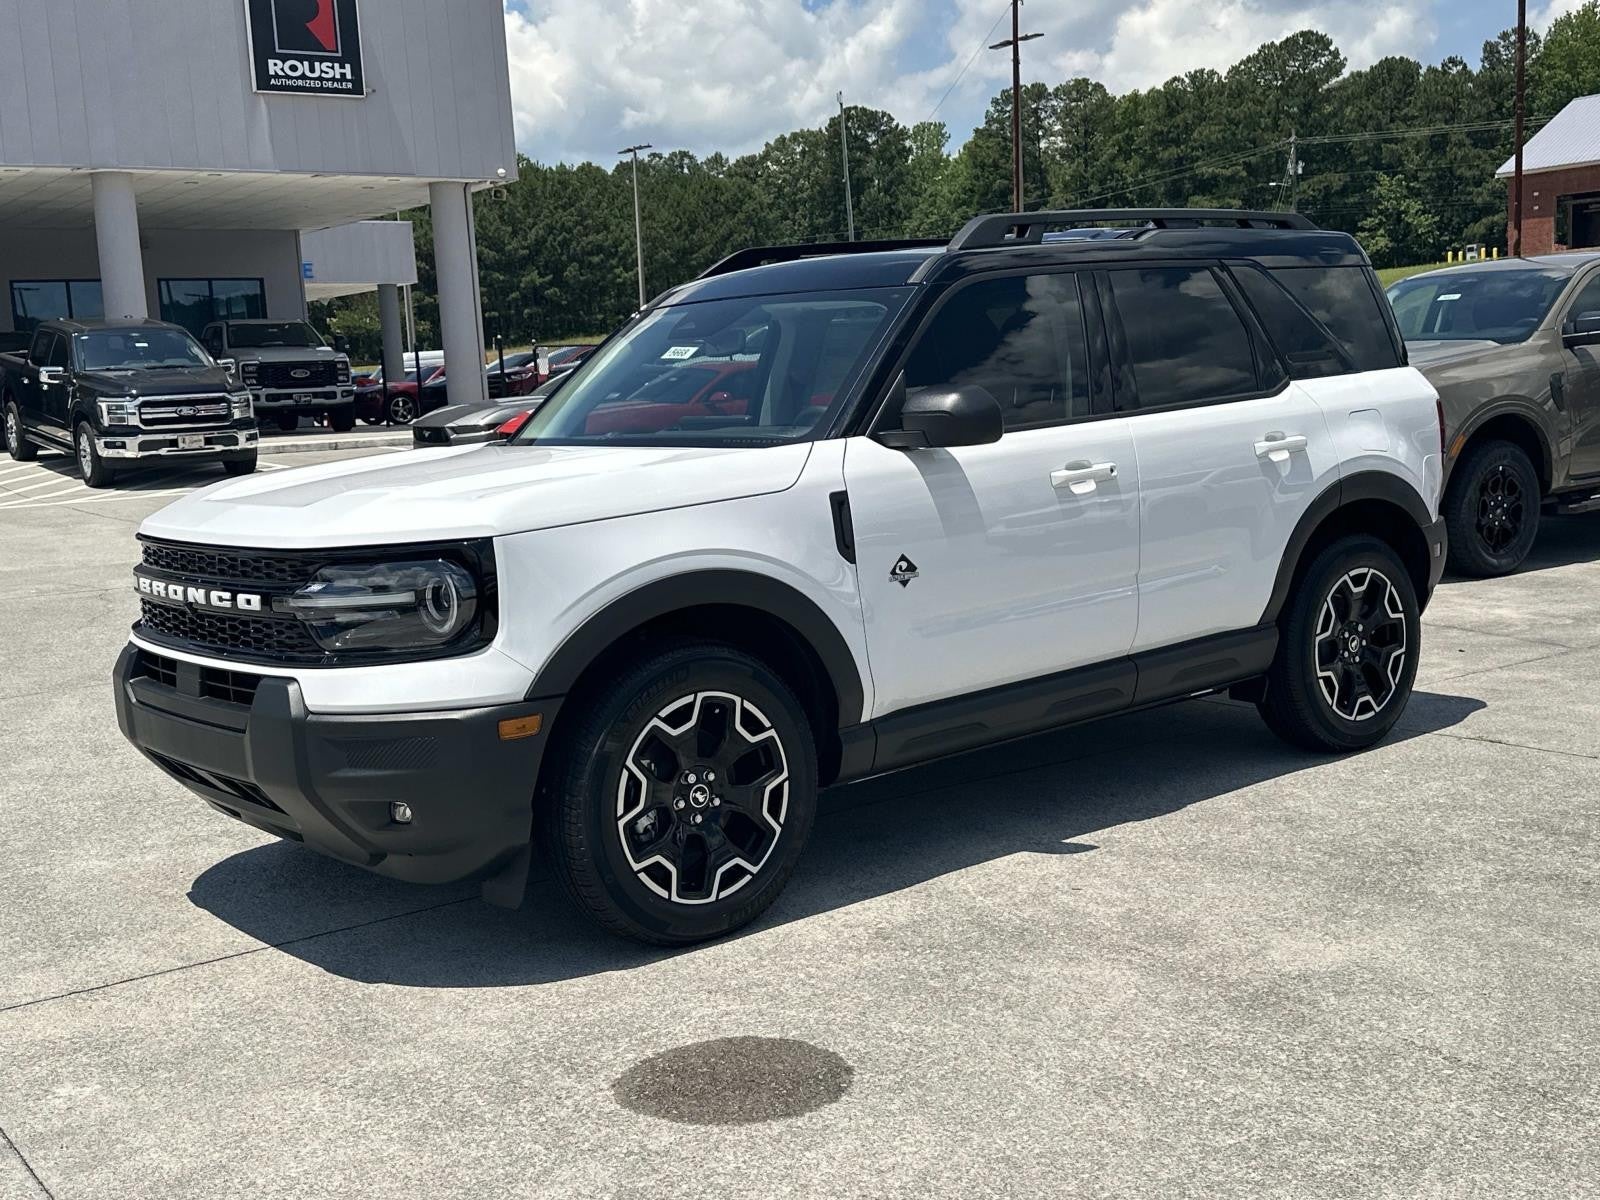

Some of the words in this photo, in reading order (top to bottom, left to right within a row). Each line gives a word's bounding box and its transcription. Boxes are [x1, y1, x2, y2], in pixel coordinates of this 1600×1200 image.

[267, 59, 352, 80] ROUSH
[270, 78, 321, 88] AUTHORIZED
[322, 81, 352, 89] DEALER
[138, 577, 261, 611] BRONCO
